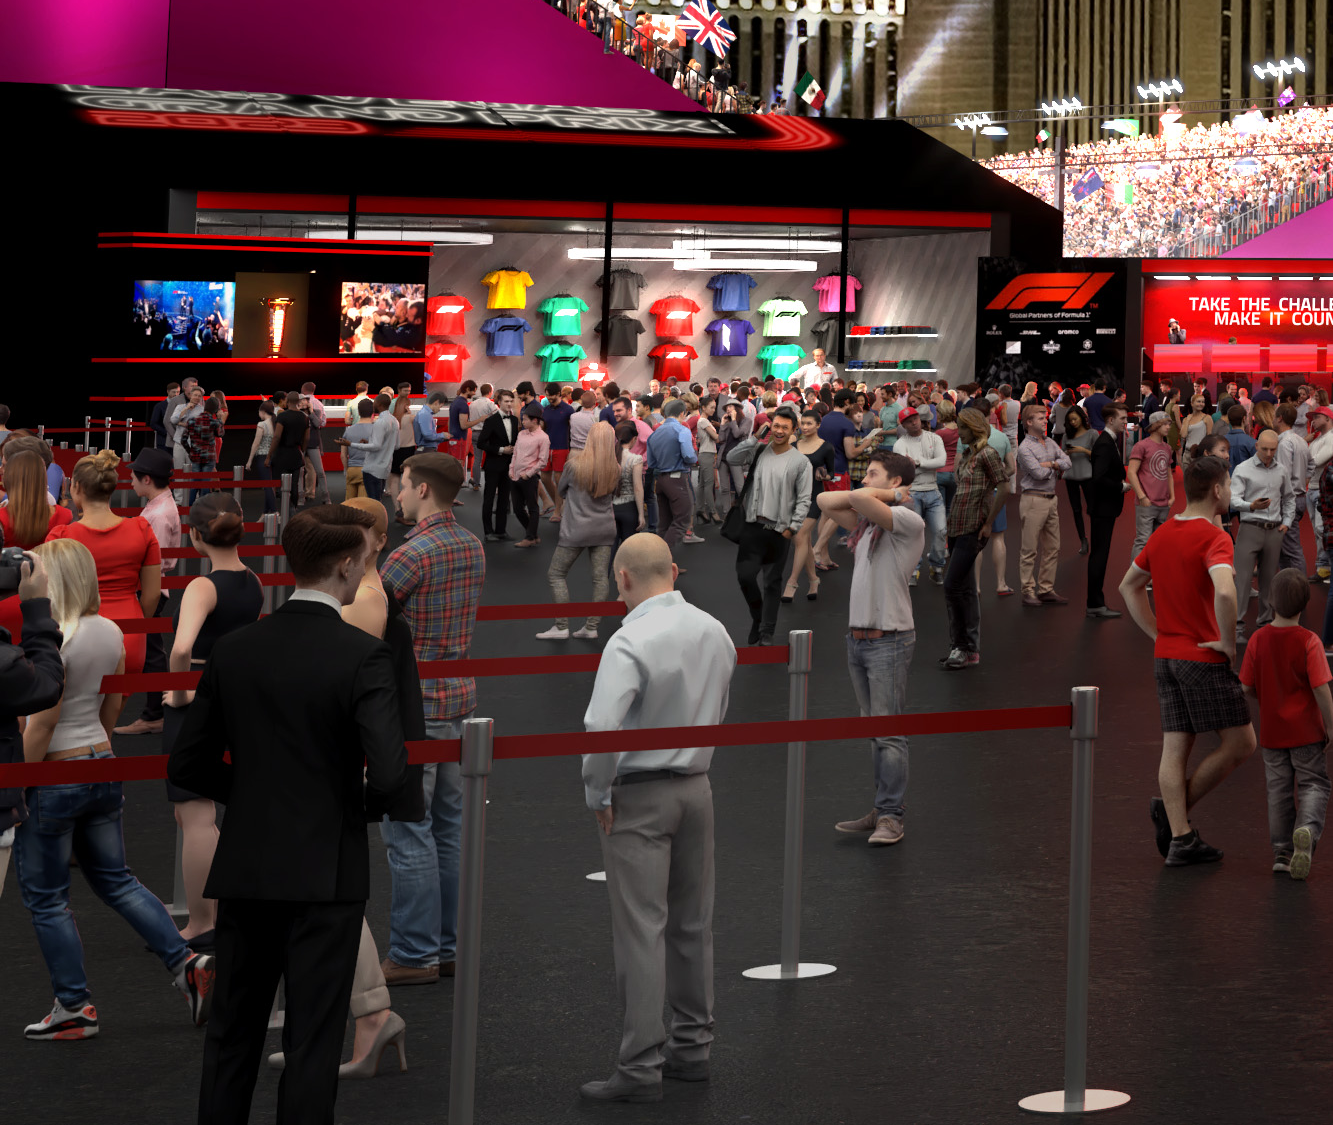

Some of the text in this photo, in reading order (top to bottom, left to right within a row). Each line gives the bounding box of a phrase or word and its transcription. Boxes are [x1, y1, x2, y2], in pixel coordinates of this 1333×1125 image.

[75, 95, 725, 134] GRAND PRIX
[86, 110, 370, 134] 2023
[1189, 297, 1230, 311] TAKE
[1238, 297, 1270, 311] THE
[1214, 312, 1260, 325] MAKE
[1270, 312, 1284, 325] IT
